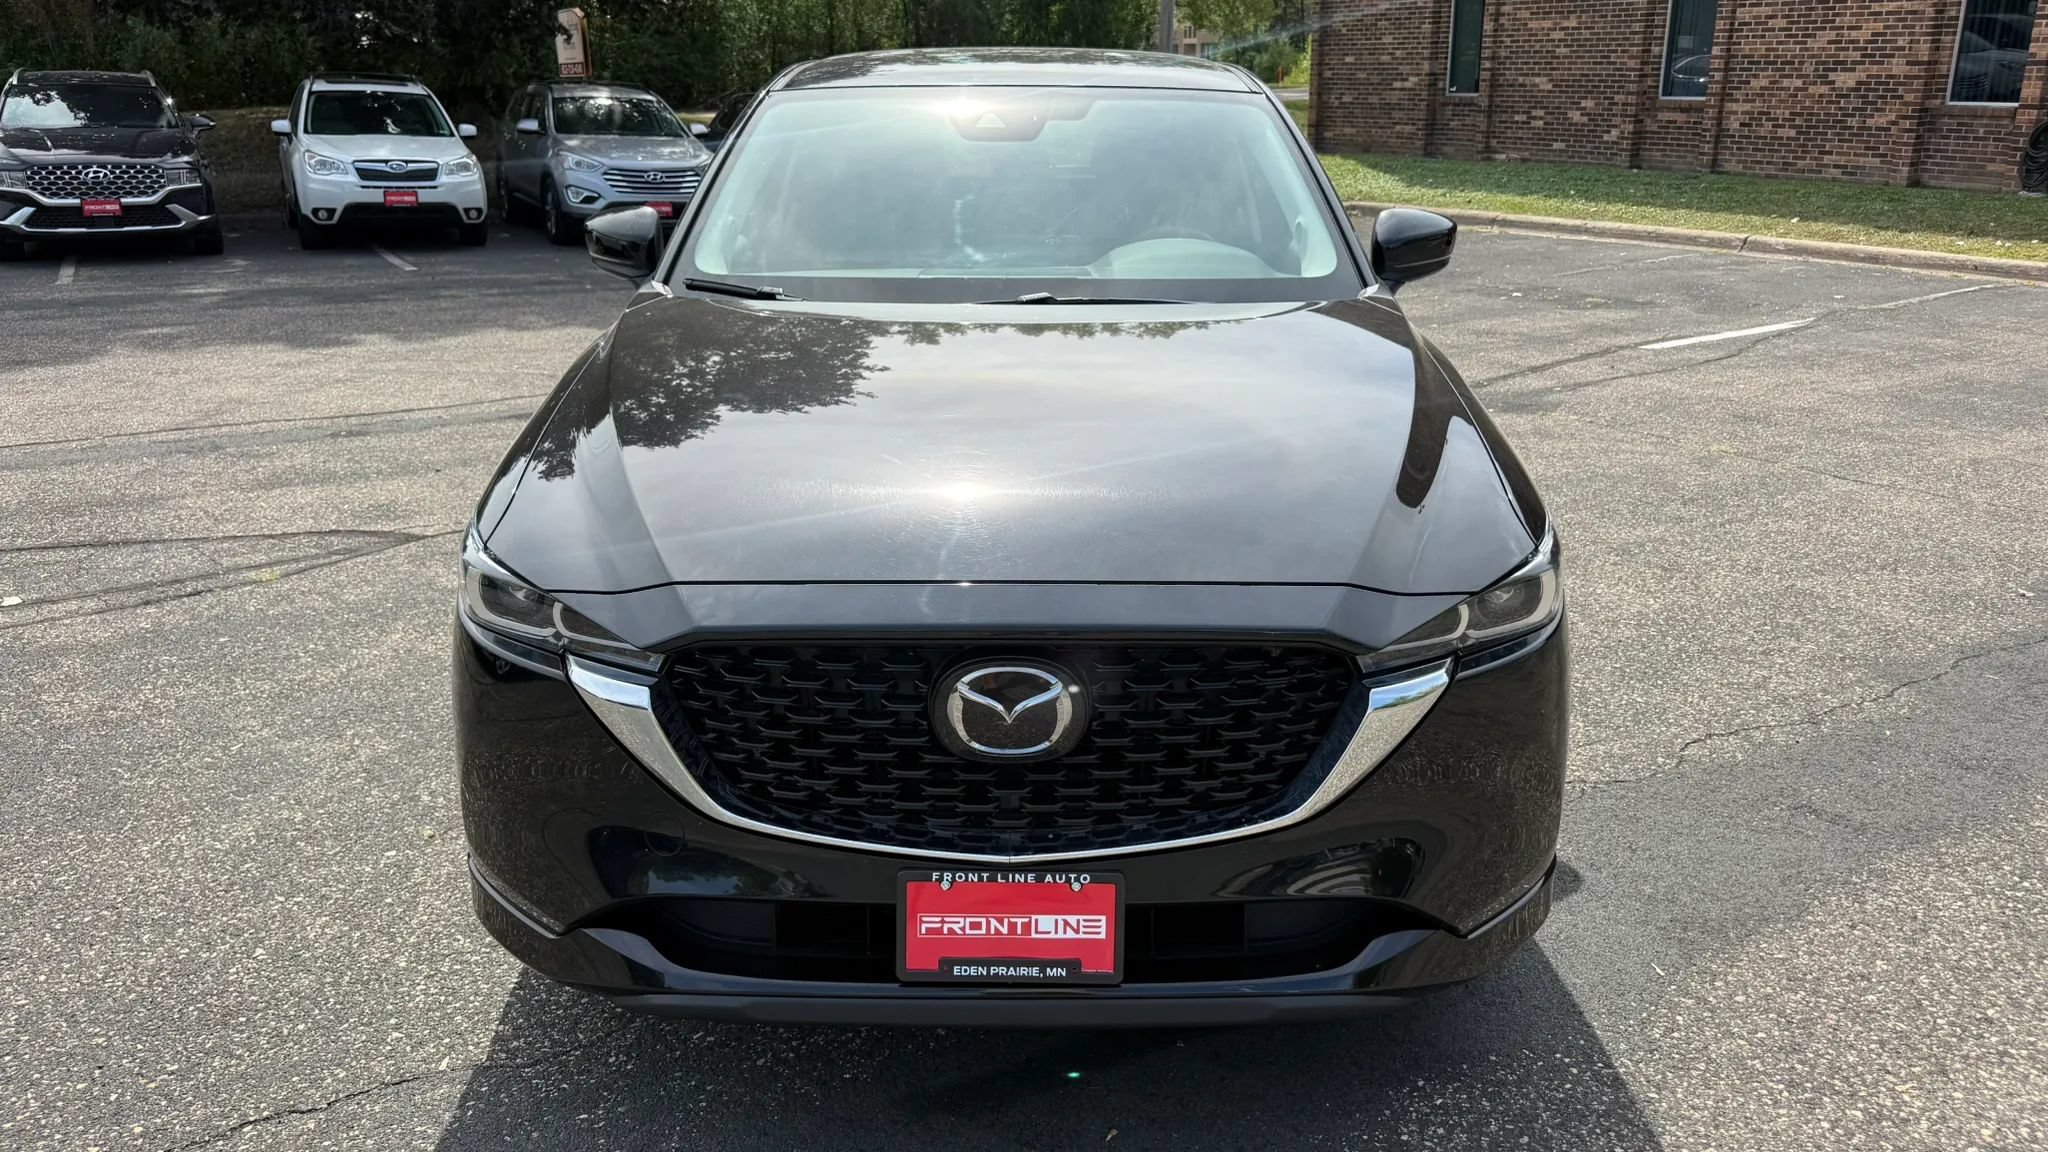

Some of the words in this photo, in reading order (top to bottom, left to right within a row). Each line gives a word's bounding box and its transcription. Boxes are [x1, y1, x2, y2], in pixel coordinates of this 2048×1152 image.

[932, 872, 990, 883] FRONT
[998, 873, 1036, 883] LINE
[1044, 873, 1091, 884] AUTO
[953, 965, 987, 976] EDEN
[990, 966, 1044, 978] PRAIRIE,
[1046, 967, 1067, 977] MN
